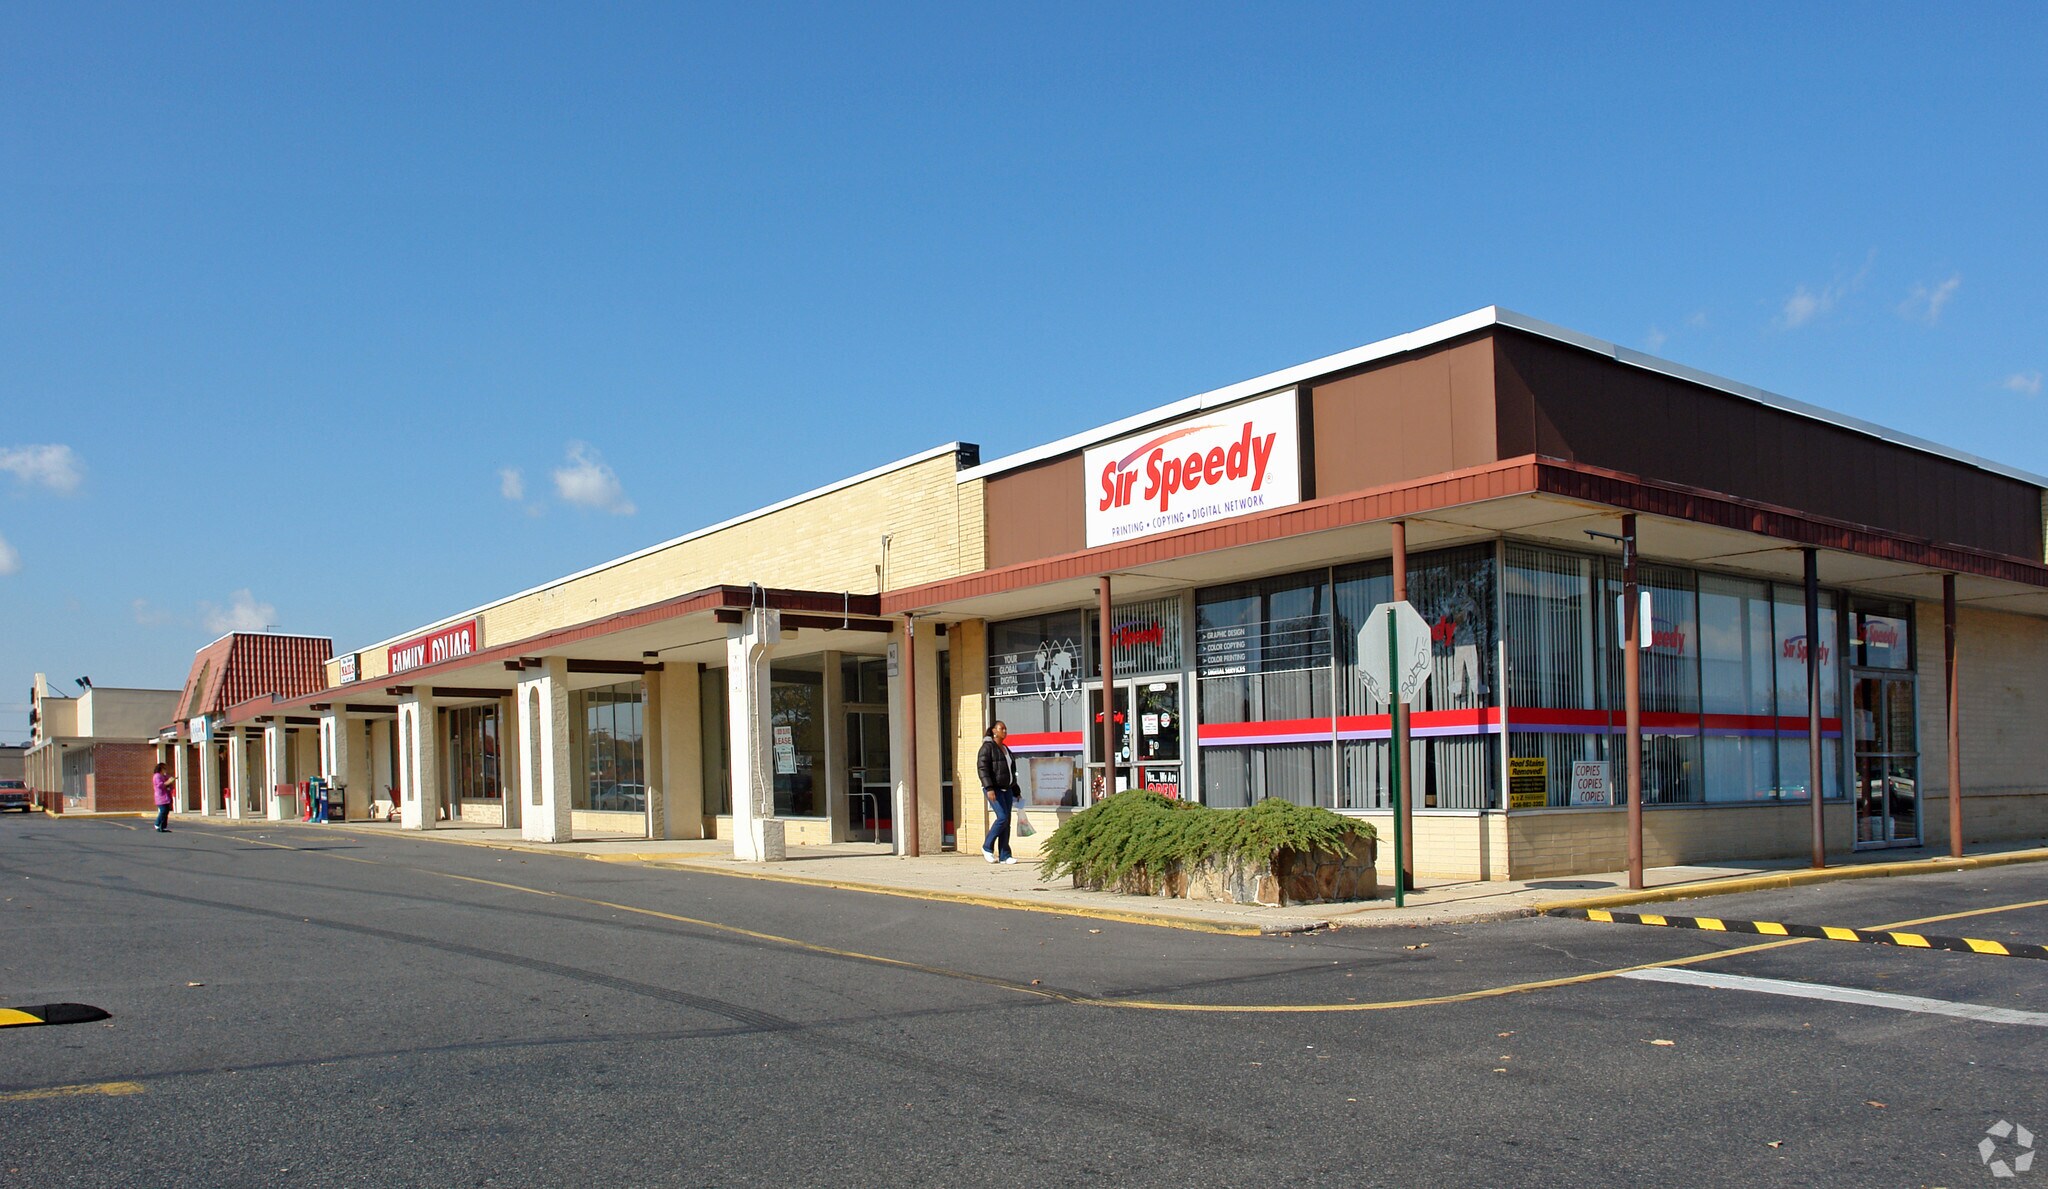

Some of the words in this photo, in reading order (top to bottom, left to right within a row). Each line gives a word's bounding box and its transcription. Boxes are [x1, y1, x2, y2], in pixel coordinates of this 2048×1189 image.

[1099, 461, 1138, 512] Sir
[1144, 421, 1277, 512] Speedy
[1112, 521, 1144, 537] PRINTING
[1152, 510, 1184, 529] COPYING
[1192, 503, 1221, 520] DIGITAL
[1224, 494, 1264, 512] NETWORK
[1121, 622, 1164, 651] Speedy
[1207, 630, 1227, 639] GRAPHIC
[1228, 628, 1245, 637] DESIGN
[1870, 624, 1898, 649] Speedy
[1207, 643, 1222, 652] COLOR
[1223, 641, 1245, 650] COPYING
[1207, 655, 1222, 663] COLOR
[1223, 653, 1245, 662] PRINTING
[1783, 639, 1795, 658] Sir
[1797, 640, 1829, 666] Spdy
[1003, 654, 1018, 664] YOUR
[999, 664, 1018, 675] GLOBAL
[775, 736, 791, 745] LEASE
[1510, 760, 1525, 768] Roof
[1525, 760, 1544, 768] Stains
[1512, 768, 1543, 776] Removed!
[1576, 765, 1600, 777] COPIES
[1578, 778, 1602, 789] COPIES
[1148, 783, 1177, 800] OPEN
[1581, 791, 1605, 802] COPIES
